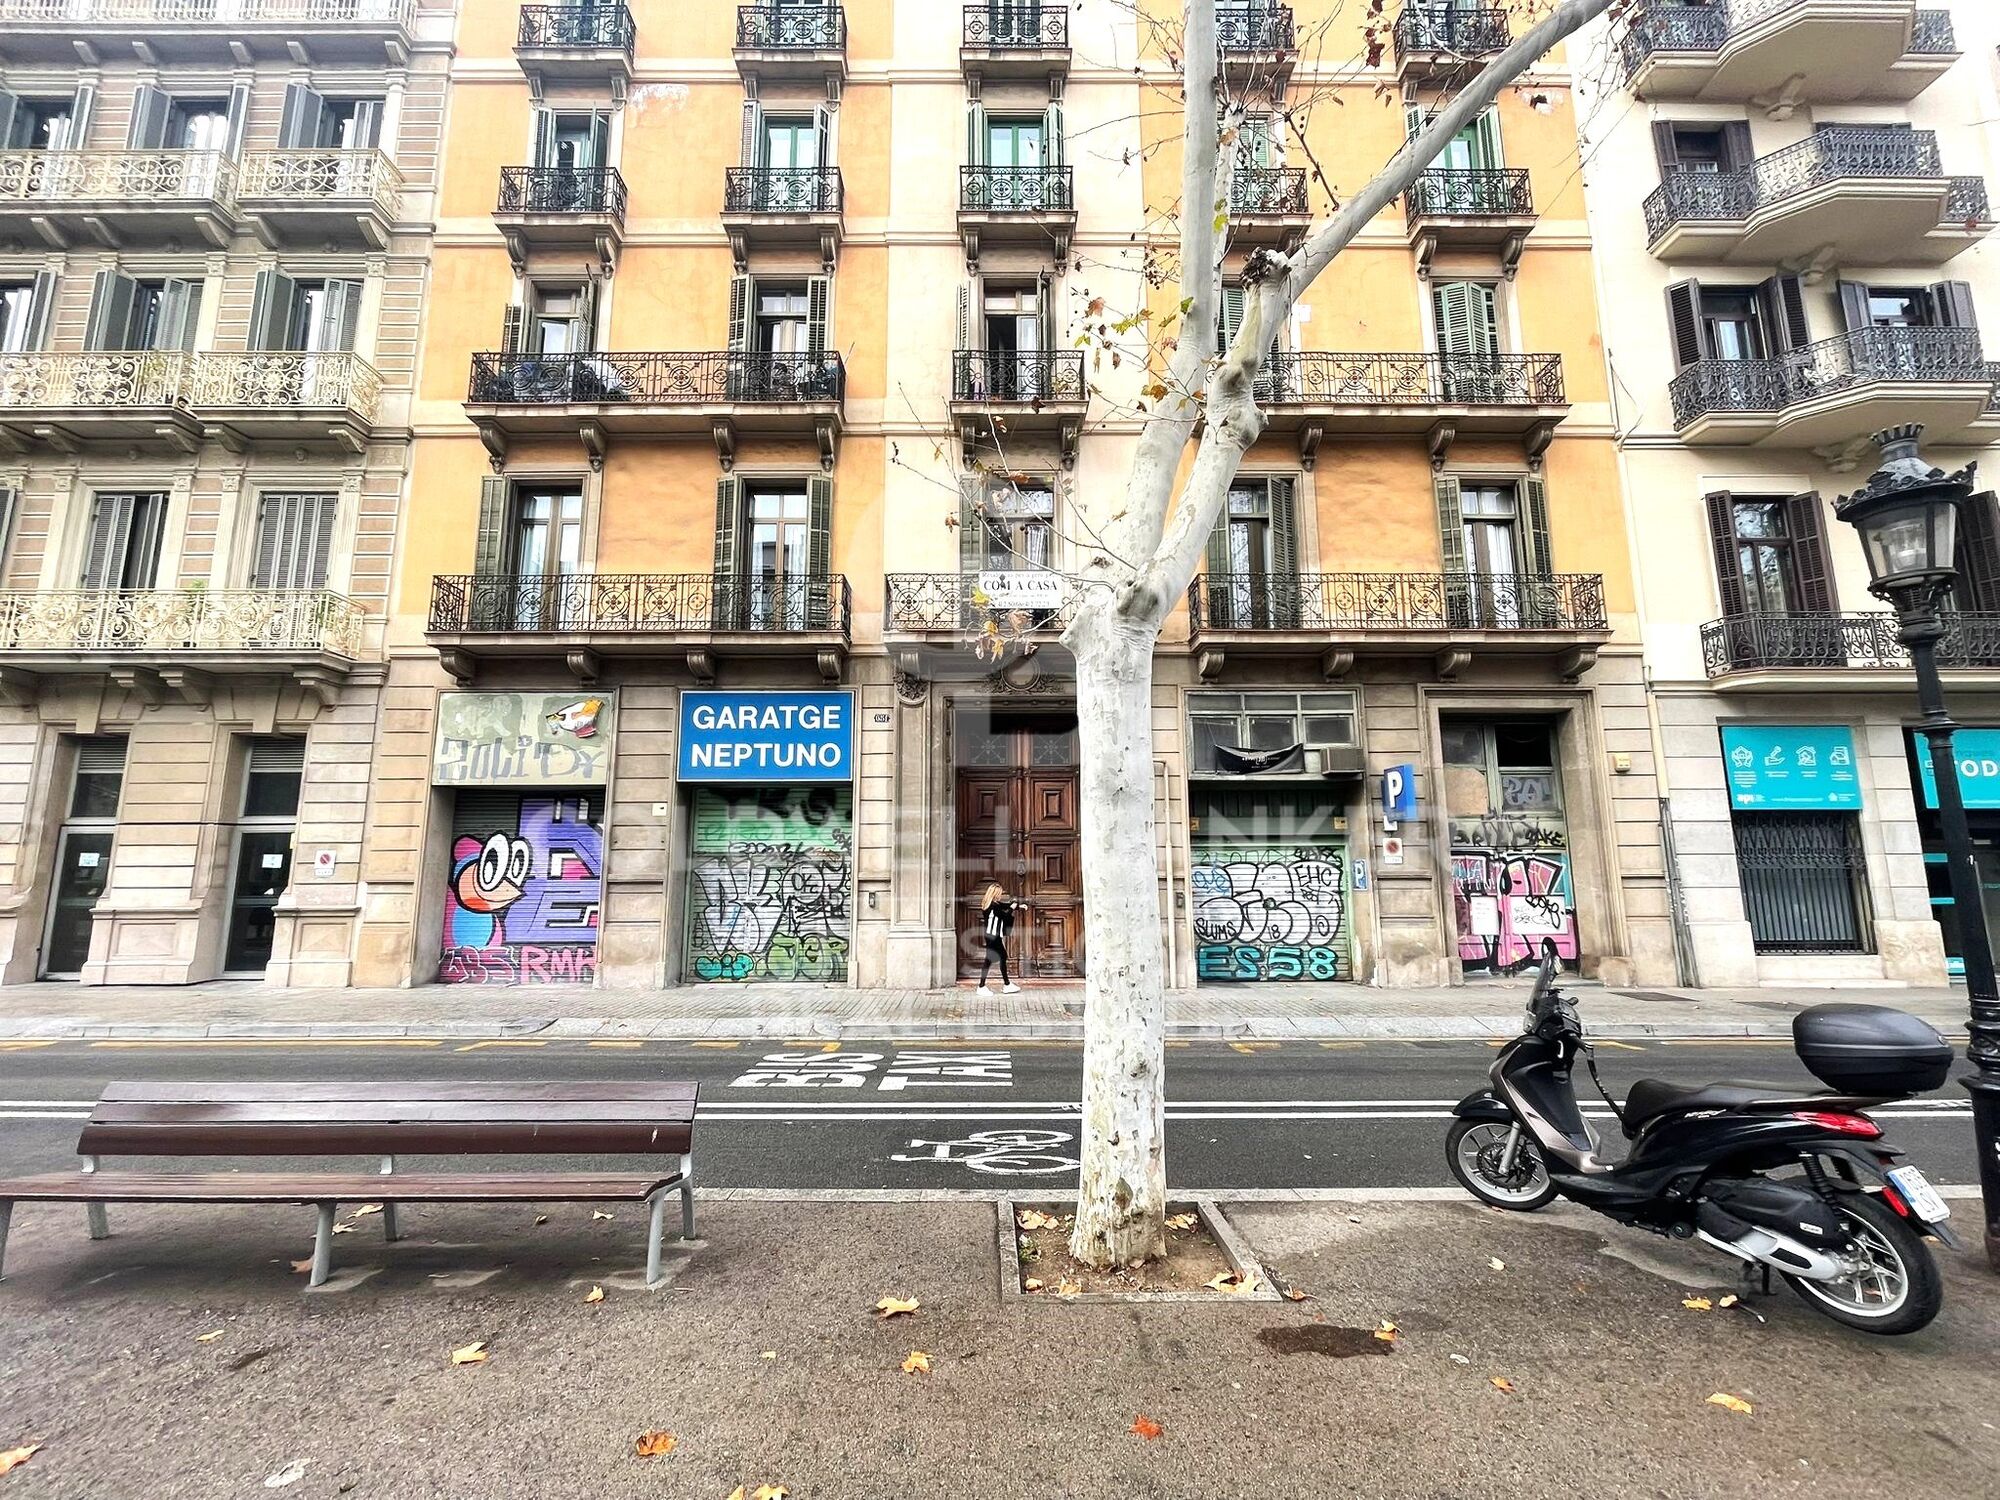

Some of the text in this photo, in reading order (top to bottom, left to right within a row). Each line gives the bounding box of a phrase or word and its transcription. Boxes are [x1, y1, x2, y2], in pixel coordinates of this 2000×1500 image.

[1015, 581, 1023, 590] A
[1027, 580, 1057, 590] CASA
[692, 705, 842, 730] GARATGE
[691, 742, 843, 768] NEPTUNO
[1387, 771, 1403, 808] P
[728, 1052, 886, 1088] BUS
[877, 1051, 1013, 1091] TAXI
